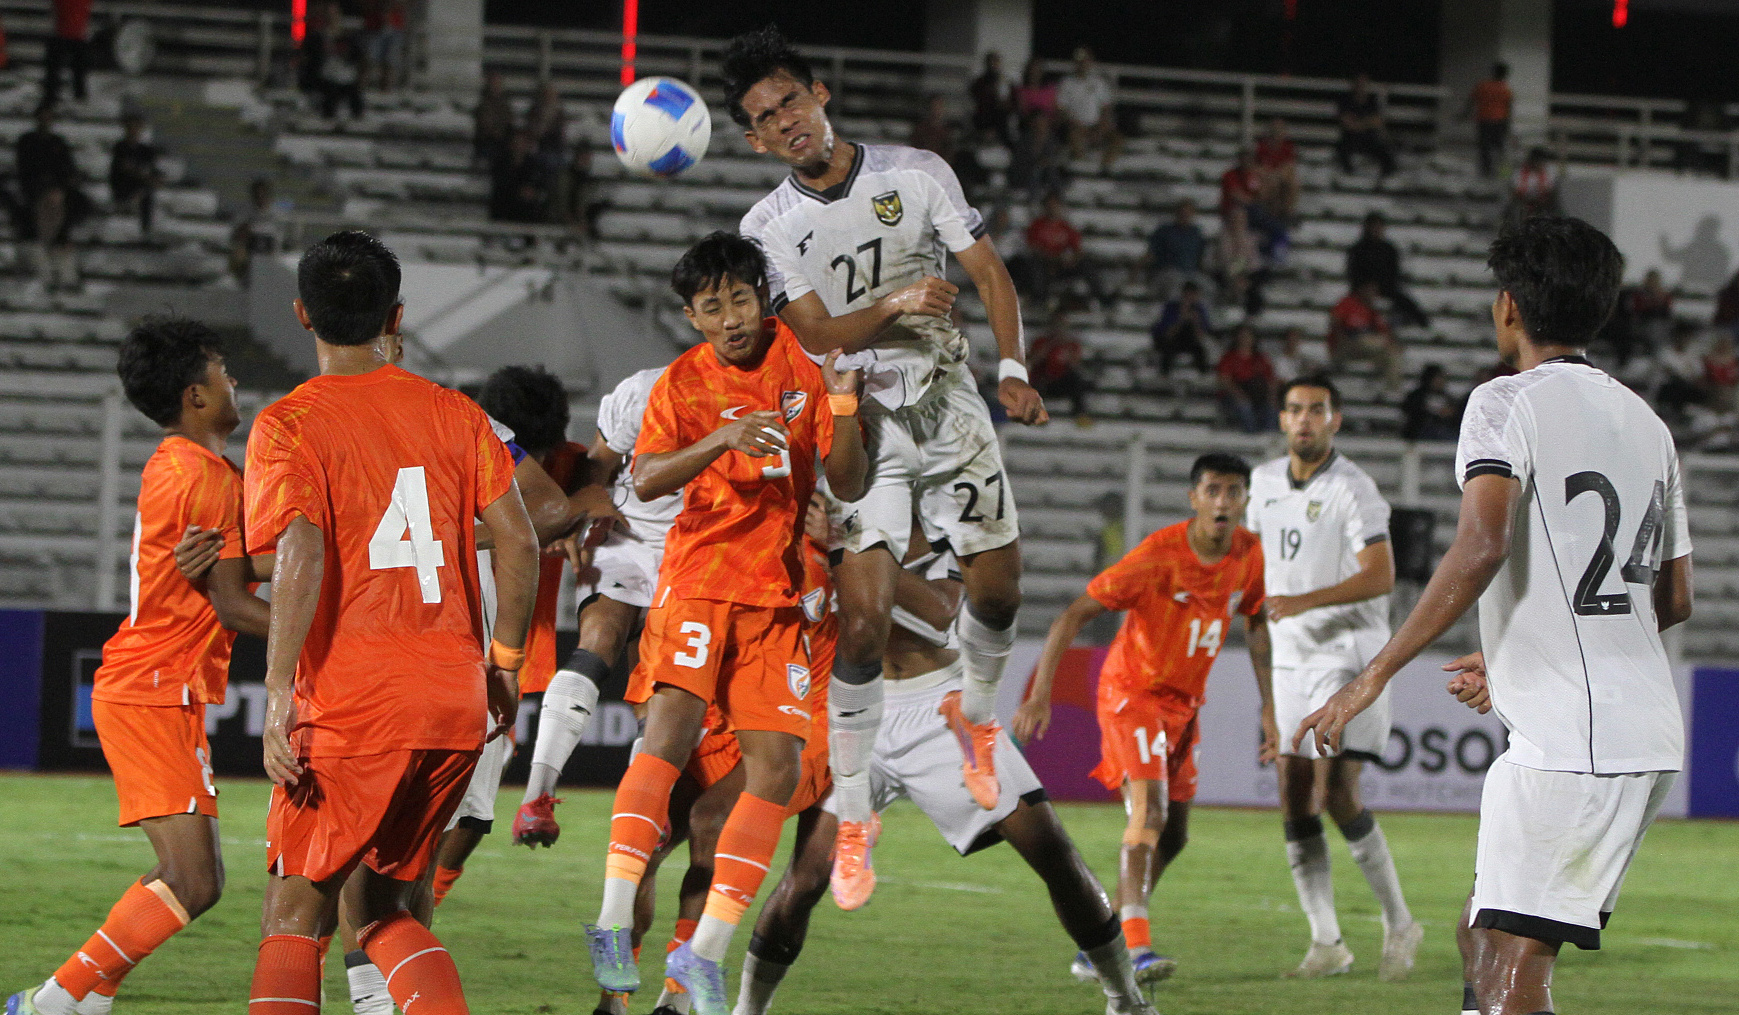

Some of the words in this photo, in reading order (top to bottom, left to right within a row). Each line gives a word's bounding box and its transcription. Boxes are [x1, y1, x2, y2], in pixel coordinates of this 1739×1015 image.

[830, 237, 883, 305] 27
[953, 471, 1004, 523] 27
[368, 466, 445, 603] 4
[1280, 528, 1301, 560] 19
[1564, 470, 1665, 616] 24
[673, 621, 711, 669] 3
[1187, 618, 1223, 658] 14
[1134, 726, 1168, 764] 14
